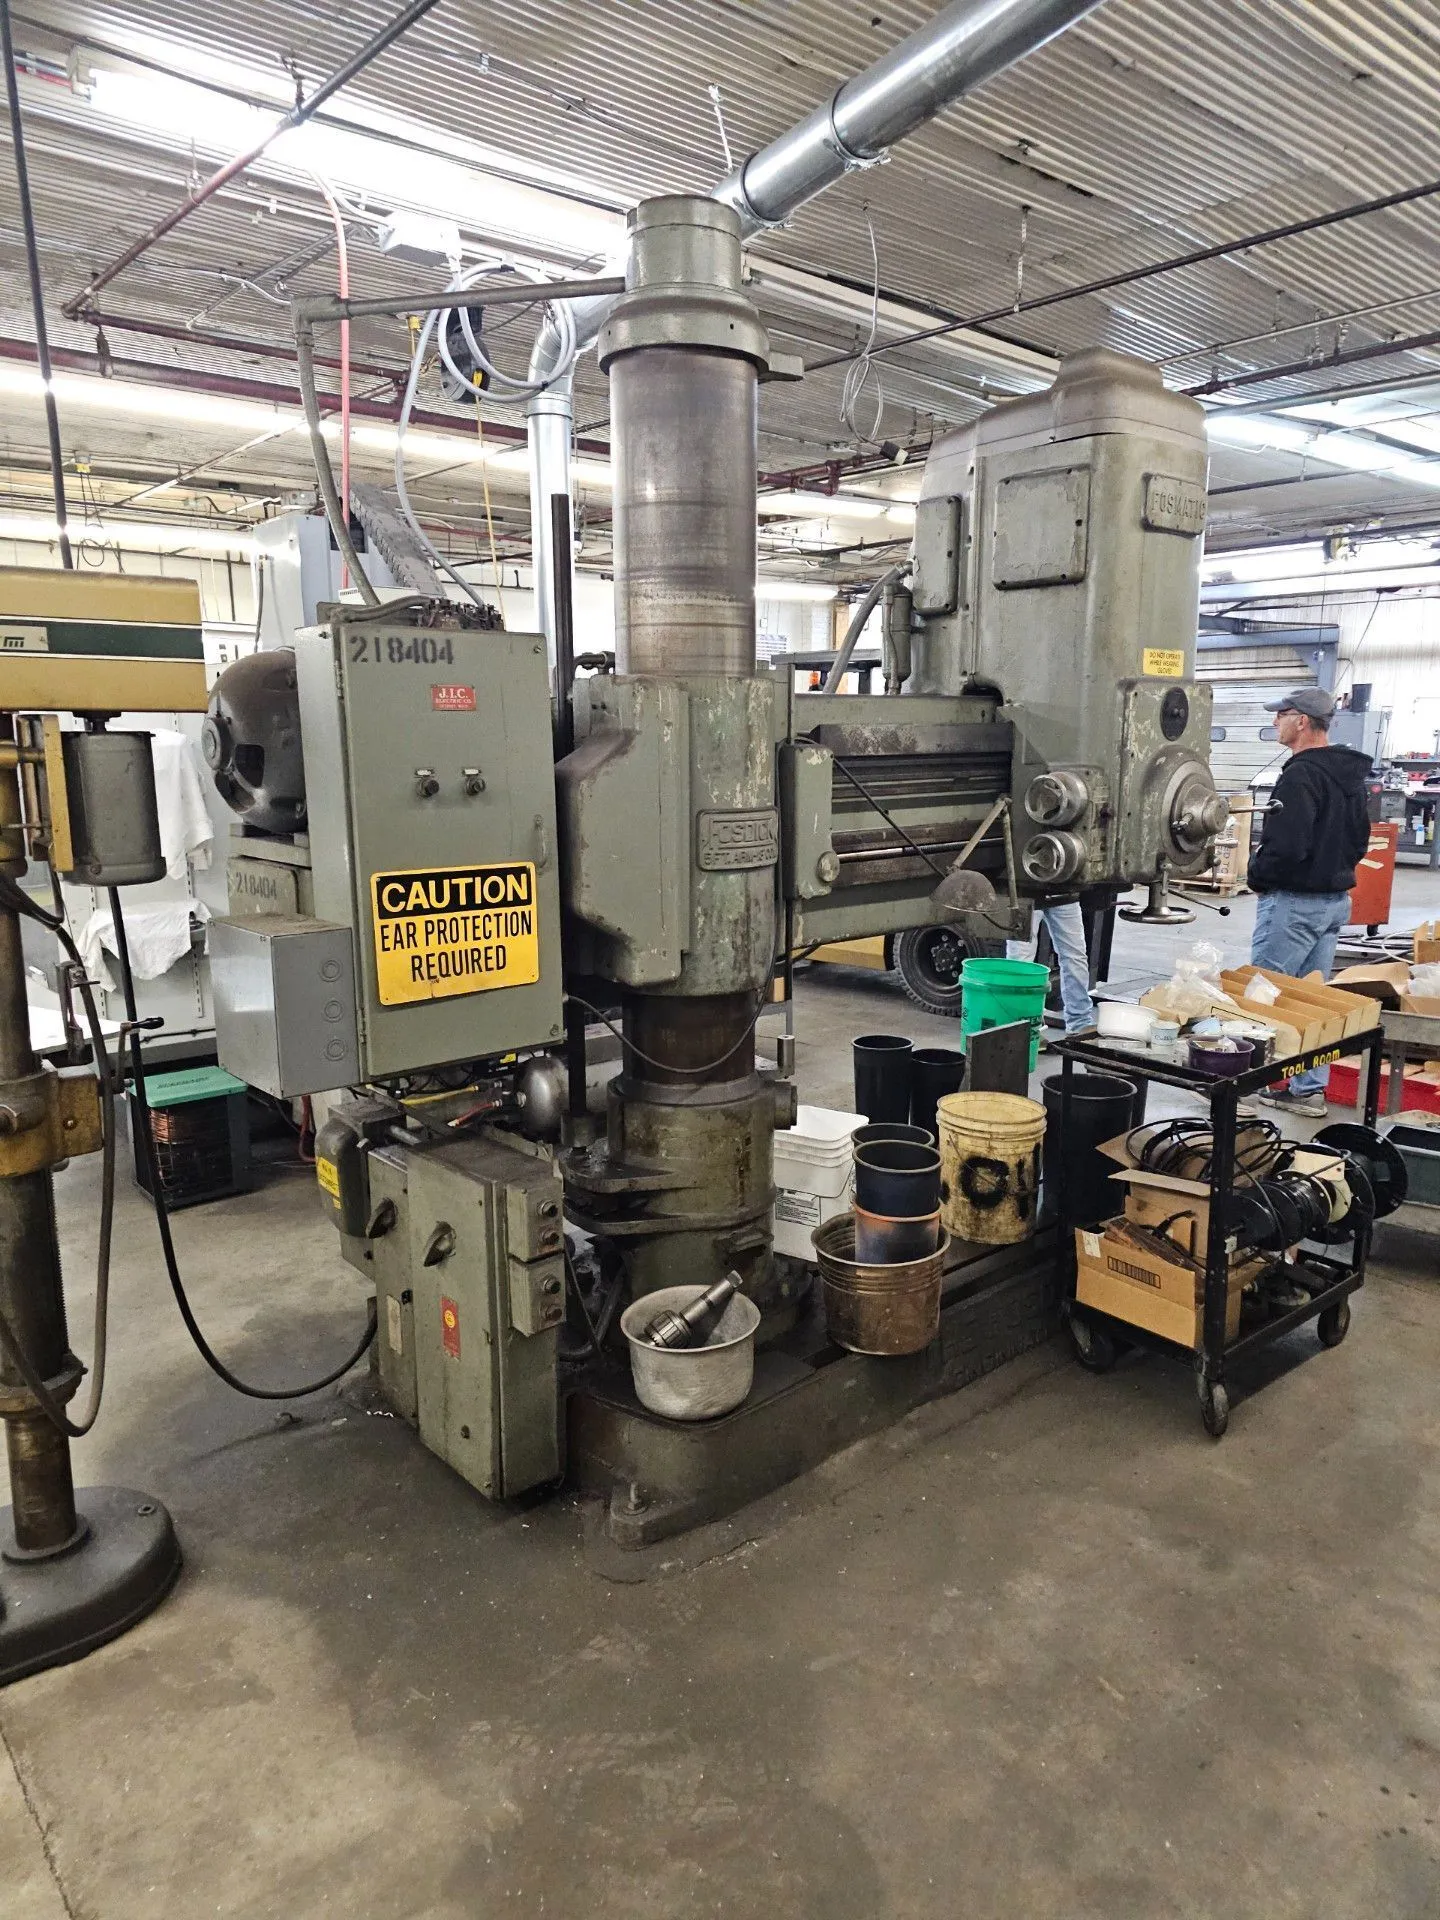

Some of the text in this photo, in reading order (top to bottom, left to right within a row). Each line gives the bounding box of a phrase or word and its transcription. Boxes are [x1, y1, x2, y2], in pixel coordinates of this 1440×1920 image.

[1151, 491, 1206, 520] FOSMATIC
[349, 636, 454, 665] 218404
[438, 688, 469, 699] J.I.C.
[235, 872, 278, 900] 218404
[381, 873, 528, 913] CAUTION
[380, 910, 532, 952] EAR PROTECTION
[410, 944, 507, 983] REQUIRED
[1281, 1048, 1341, 1081] TOOL ROOM
